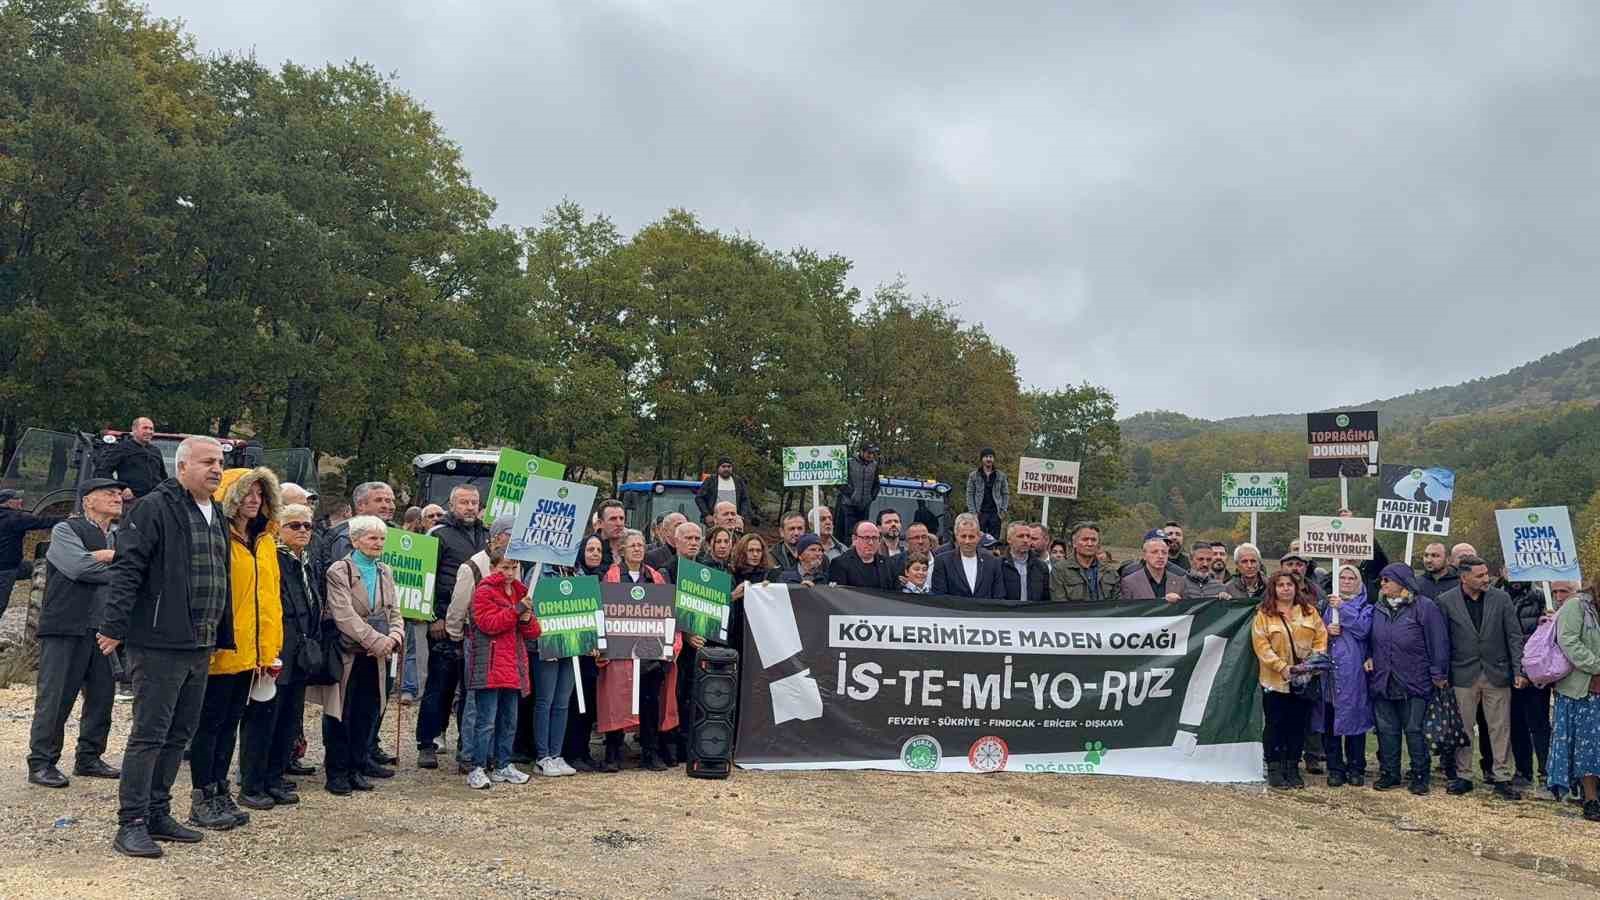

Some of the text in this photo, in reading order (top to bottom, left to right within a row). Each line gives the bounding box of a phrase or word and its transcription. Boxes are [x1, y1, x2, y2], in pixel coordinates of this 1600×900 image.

[1311, 429, 1375, 443] TOPRAĞIMA
[799, 460, 832, 470] DOĞAMI
[789, 470, 842, 481] KORUYORUM
[1025, 472, 1074, 485] TOZ YUTMAK
[1237, 486, 1272, 496] DOĞAMI
[536, 499, 576, 518] SUSMA
[1228, 497, 1280, 507] KORUYORUM
[1382, 500, 1428, 514] MADENE
[531, 513, 572, 533] SUSUZ
[523, 528, 573, 548] KALMA!
[1307, 531, 1367, 543] TOZ YUTMAK
[1514, 526, 1557, 539] SUSMA
[1517, 539, 1558, 551] SUSUZ
[1515, 552, 1566, 568] KALMA!
[681, 579, 727, 604] ORMANIMA
[539, 597, 598, 615] ORMANIMA
[839, 620, 1176, 649] KÖYLERİMİZDE MADEN OCAĞI
[888, 716, 930, 725] FEVZİYE
[989, 719, 1036, 727] FINDICAK
